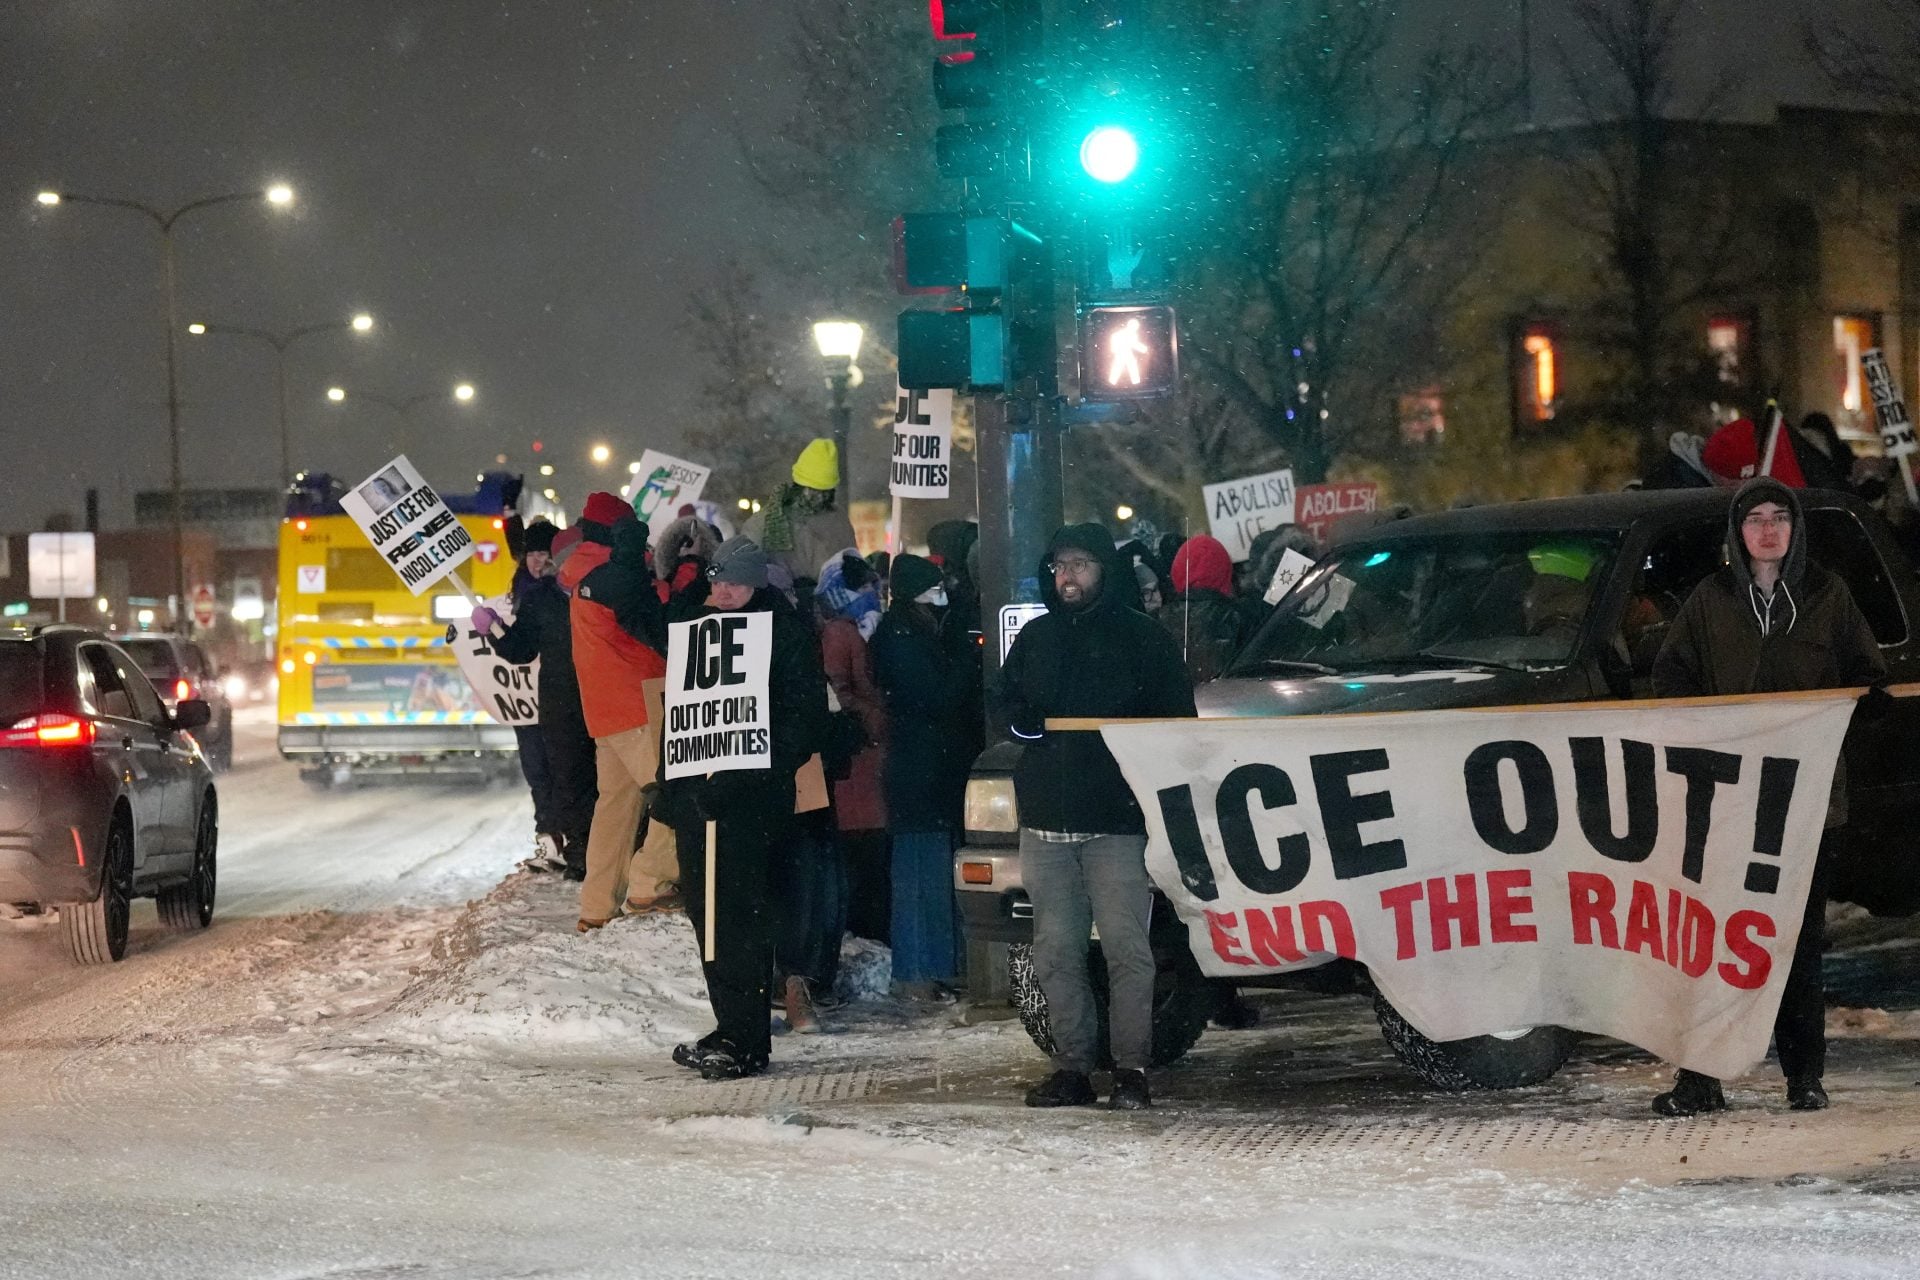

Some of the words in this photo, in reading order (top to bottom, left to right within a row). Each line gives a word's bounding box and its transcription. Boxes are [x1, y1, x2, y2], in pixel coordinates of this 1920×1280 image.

[908, 434, 941, 459] OUR
[668, 463, 702, 485] RESIST
[891, 461, 948, 487] UNITIES
[369, 495, 422, 546] JUSTICE
[413, 485, 440, 512] FOR
[1215, 477, 1293, 520] ABOLISH
[1301, 488, 1377, 521] ABOLISH
[386, 509, 456, 565] RENEE
[400, 545, 446, 587] NICOLE
[437, 526, 472, 558] GOOD
[683, 616, 748, 691] ICE
[492, 664, 534, 690] OUT
[670, 702, 701, 733] OUT
[701, 699, 721, 728] OF
[722, 695, 758, 725] OUR
[666, 728, 769, 766] COMMUNITIES
[1156, 748, 1408, 902] ICE
[1463, 736, 1800, 894] OUT!
[1202, 900, 1357, 967] END
[1379, 869, 1538, 960] THE
[1567, 871, 1777, 990] RAIDS
